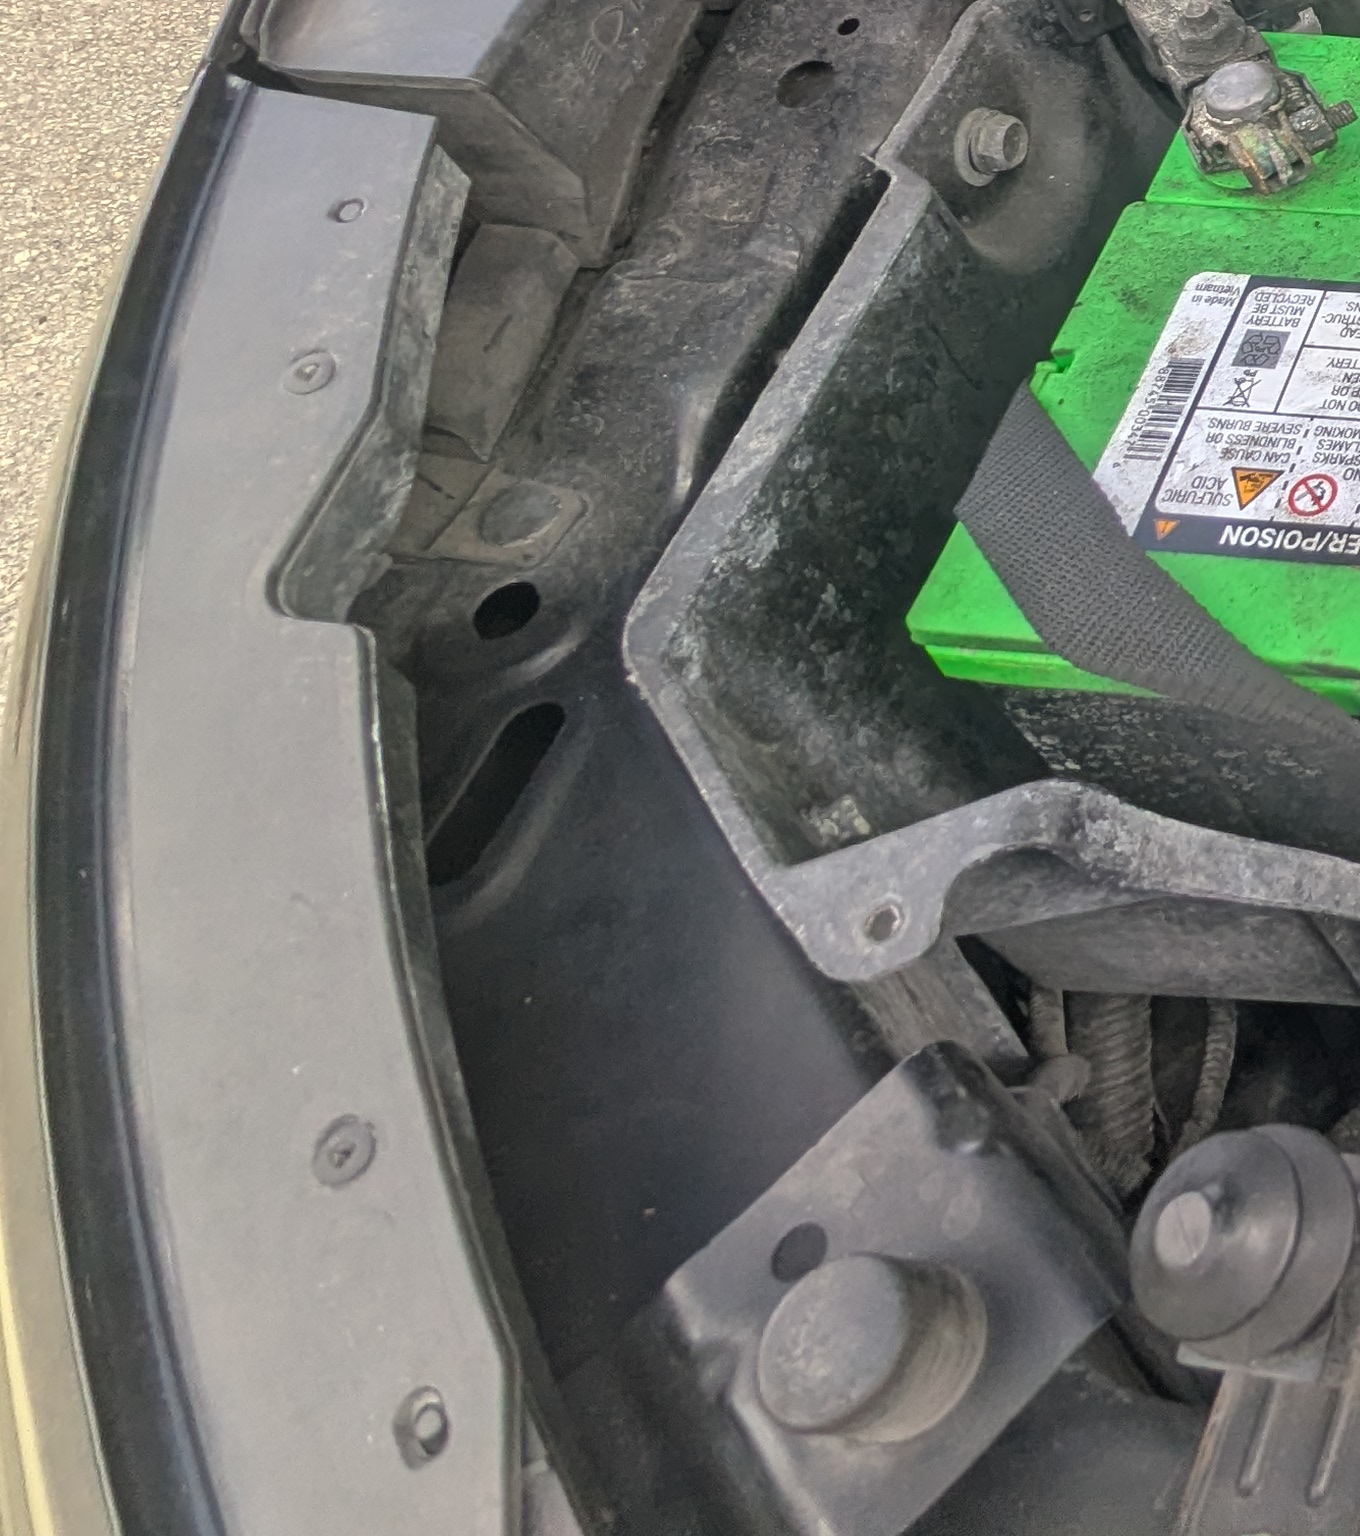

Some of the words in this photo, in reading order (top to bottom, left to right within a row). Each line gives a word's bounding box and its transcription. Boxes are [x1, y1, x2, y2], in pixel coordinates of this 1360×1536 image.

[1194, 281, 1241, 295] Vietnam
[1191, 294, 1200, 303] in
[1203, 294, 1236, 307] Made
[1253, 290, 1315, 305] RECYCLED.
[1250, 302, 1268, 313] BE
[1271, 303, 1305, 315] MUST
[1245, 313, 1300, 327] BATTERY
[1242, 368, 1257, 376] Pb
[1331, 384, 1348, 396] OR
[1319, 398, 1345, 410] NOT
[1207, 417, 1251, 431] BURNS.
[1253, 420, 1302, 435] SEVERE
[1205, 432, 1224, 443] OR
[1225, 433, 1296, 449] BLINDNESS
[1218, 446, 1261, 461] CAUSE
[1263, 450, 1290, 463] CAN
[1190, 475, 1227, 490] ACID
[1160, 488, 1233, 506] SULFURIC
